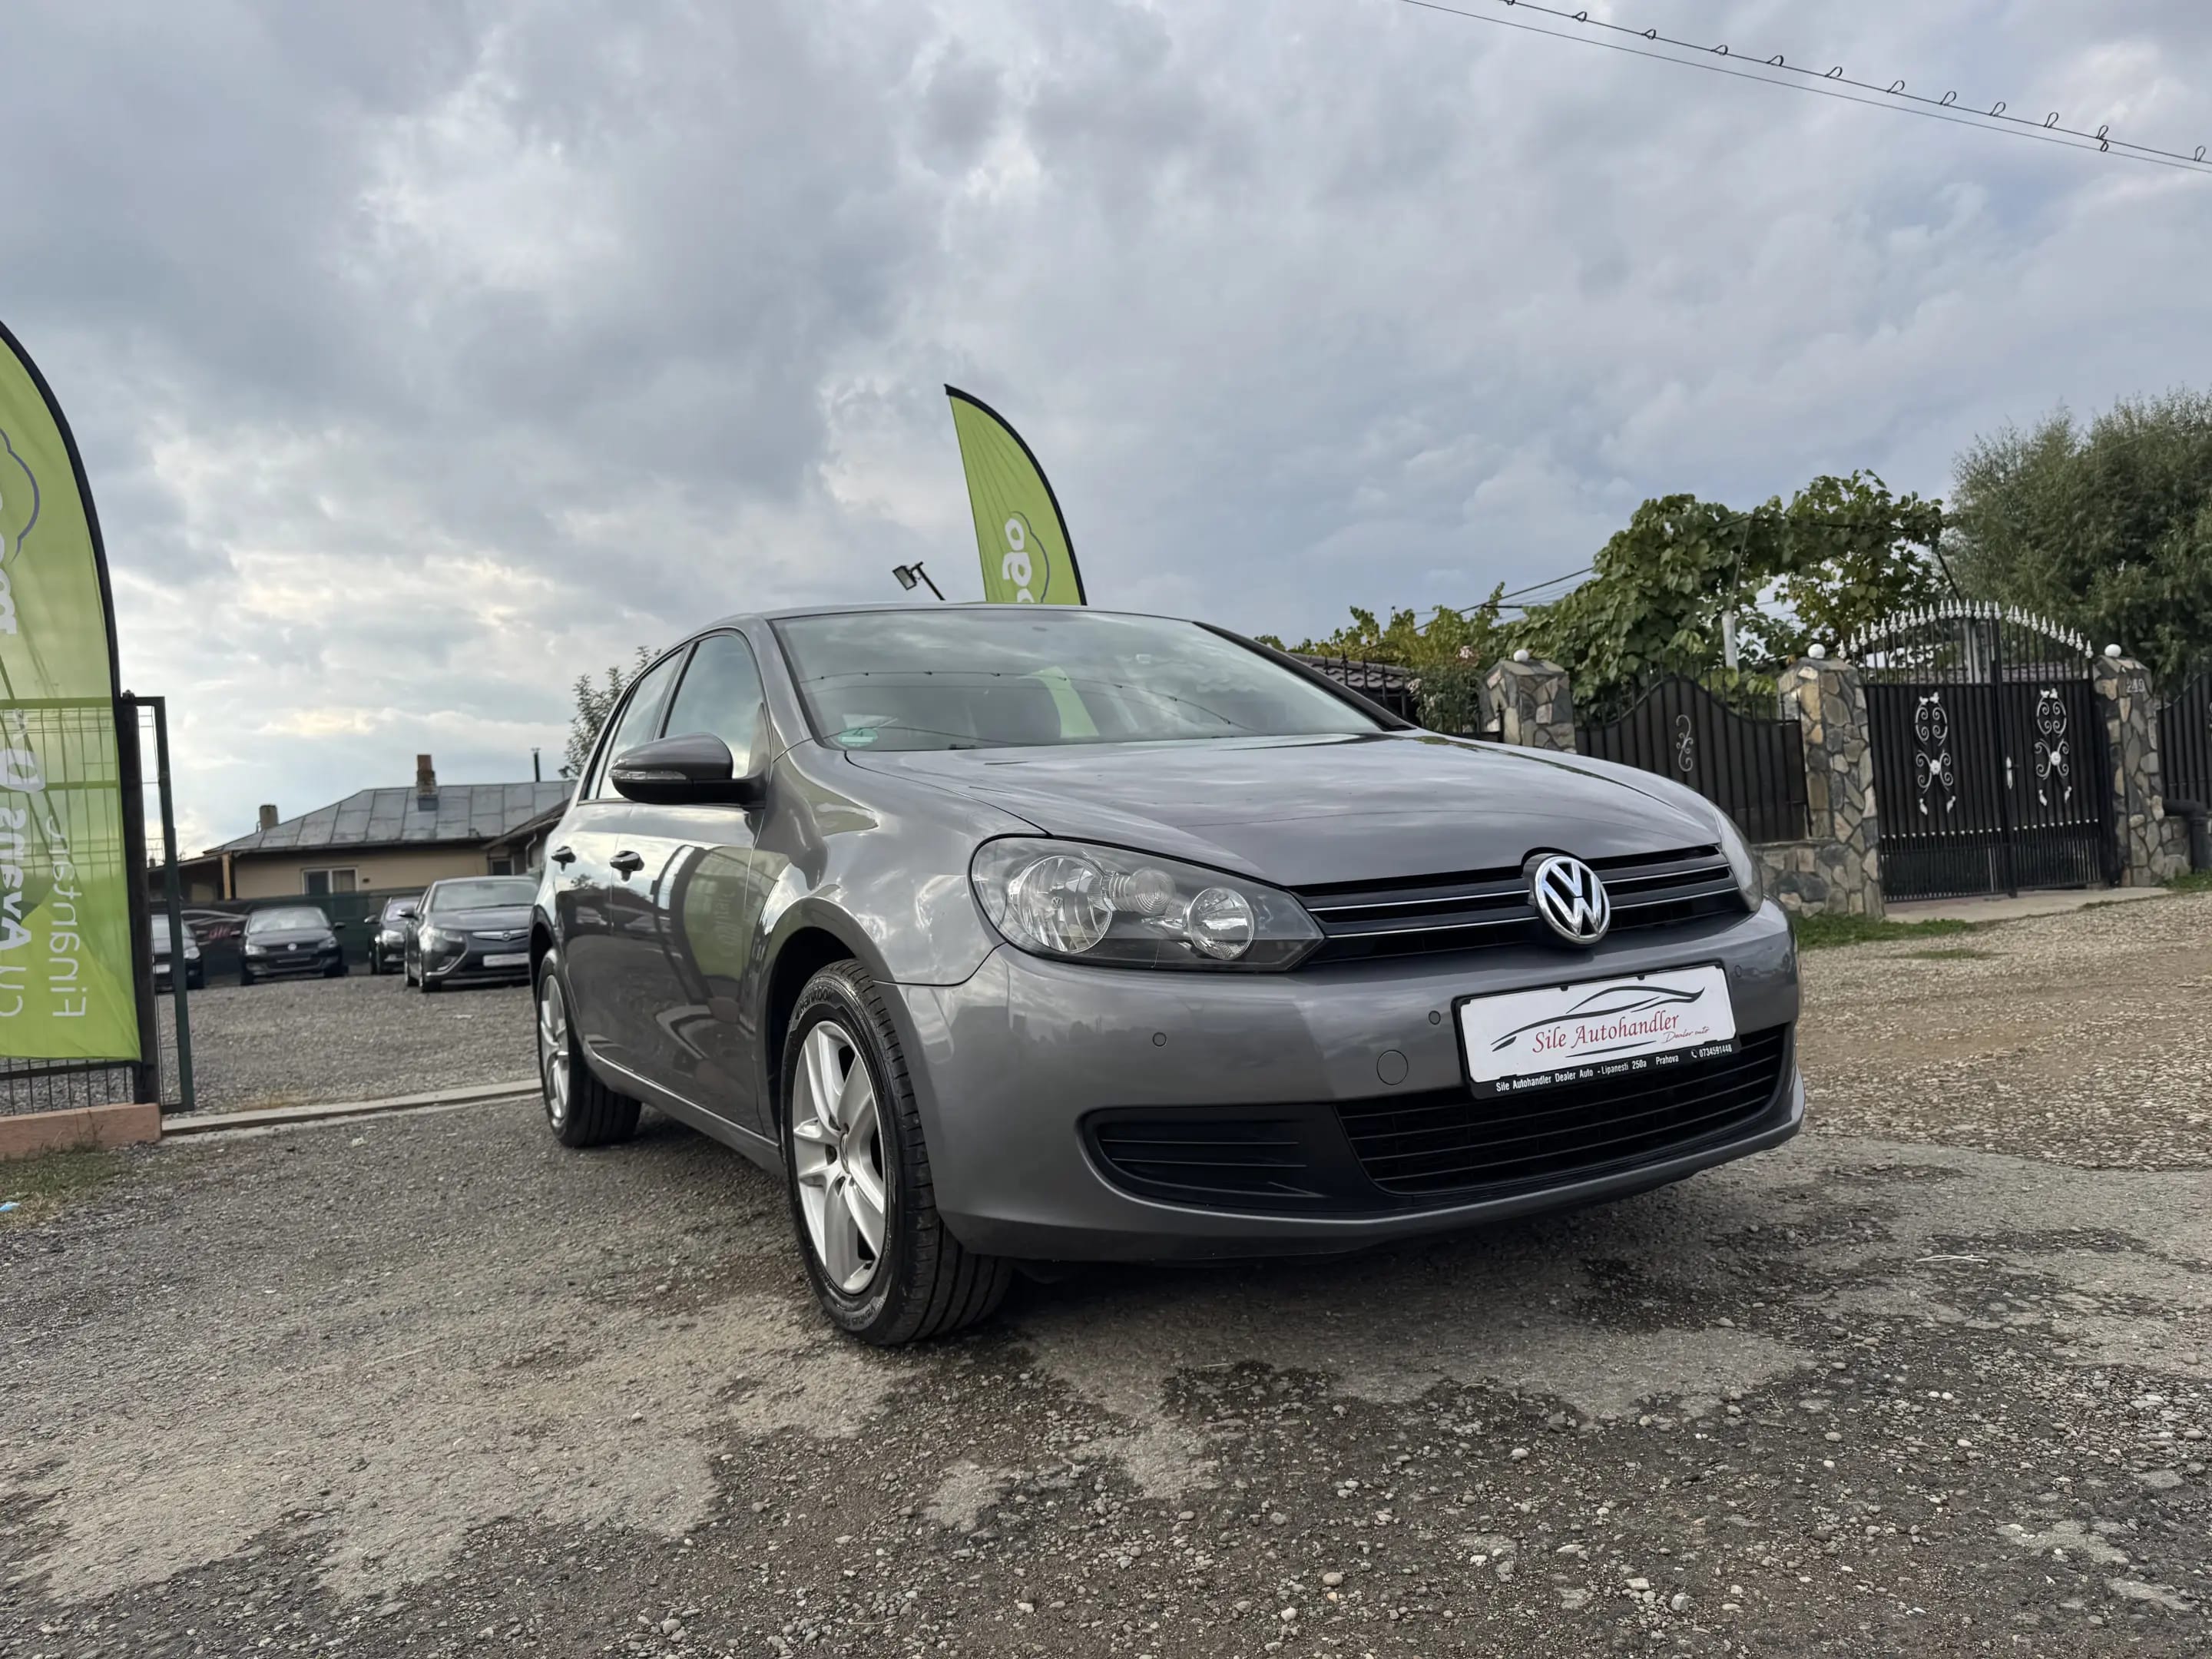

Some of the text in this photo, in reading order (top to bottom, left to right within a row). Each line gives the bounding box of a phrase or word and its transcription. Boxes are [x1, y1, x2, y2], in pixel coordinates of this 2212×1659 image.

[1537, 856, 1608, 940] VW
[1532, 1010, 1680, 1053] Sile Autohandler
[1495, 1081, 1510, 1091] Sile
[1512, 1075, 1551, 1089] Autohandler
[1555, 1071, 1576, 1082] Dealer
[1579, 1068, 1594, 1078] Auto
[1632, 1059, 1647, 1070] 250a
[1655, 1054, 1679, 1065] Prahova
